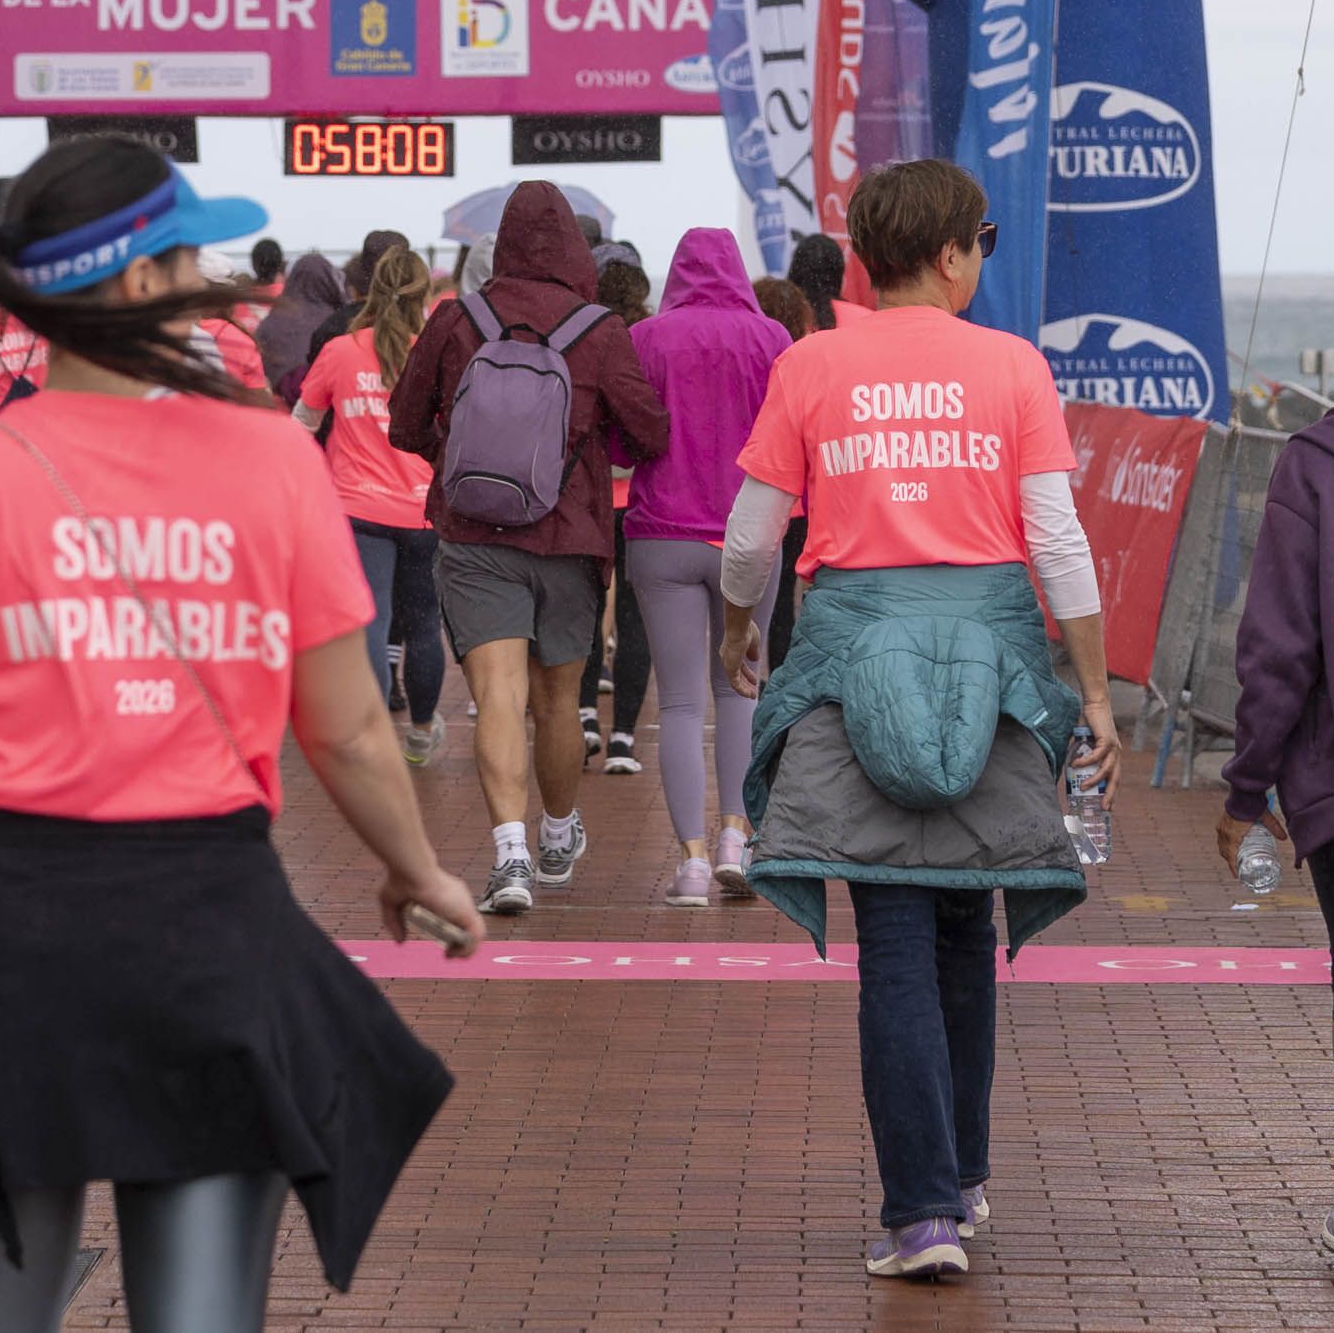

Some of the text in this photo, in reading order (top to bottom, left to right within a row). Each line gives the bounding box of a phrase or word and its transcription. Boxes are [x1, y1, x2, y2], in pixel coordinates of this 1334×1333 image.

[575, 68, 651, 89] OYSHO
[533, 130, 643, 154] OYSHO
[1055, 126, 1183, 141] TRAL LECHERA
[1049, 145, 1190, 179] URIANA
[1117, 357, 1196, 373] LECHERA
[851, 382, 964, 422] SOMOS
[819, 430, 1002, 477] IMPARABLES
[890, 482, 929, 502] 2026
[52, 517, 235, 585] SOMOS
[0, 597, 290, 670] IMPARABLES
[491, 955, 859, 966] YSHO
